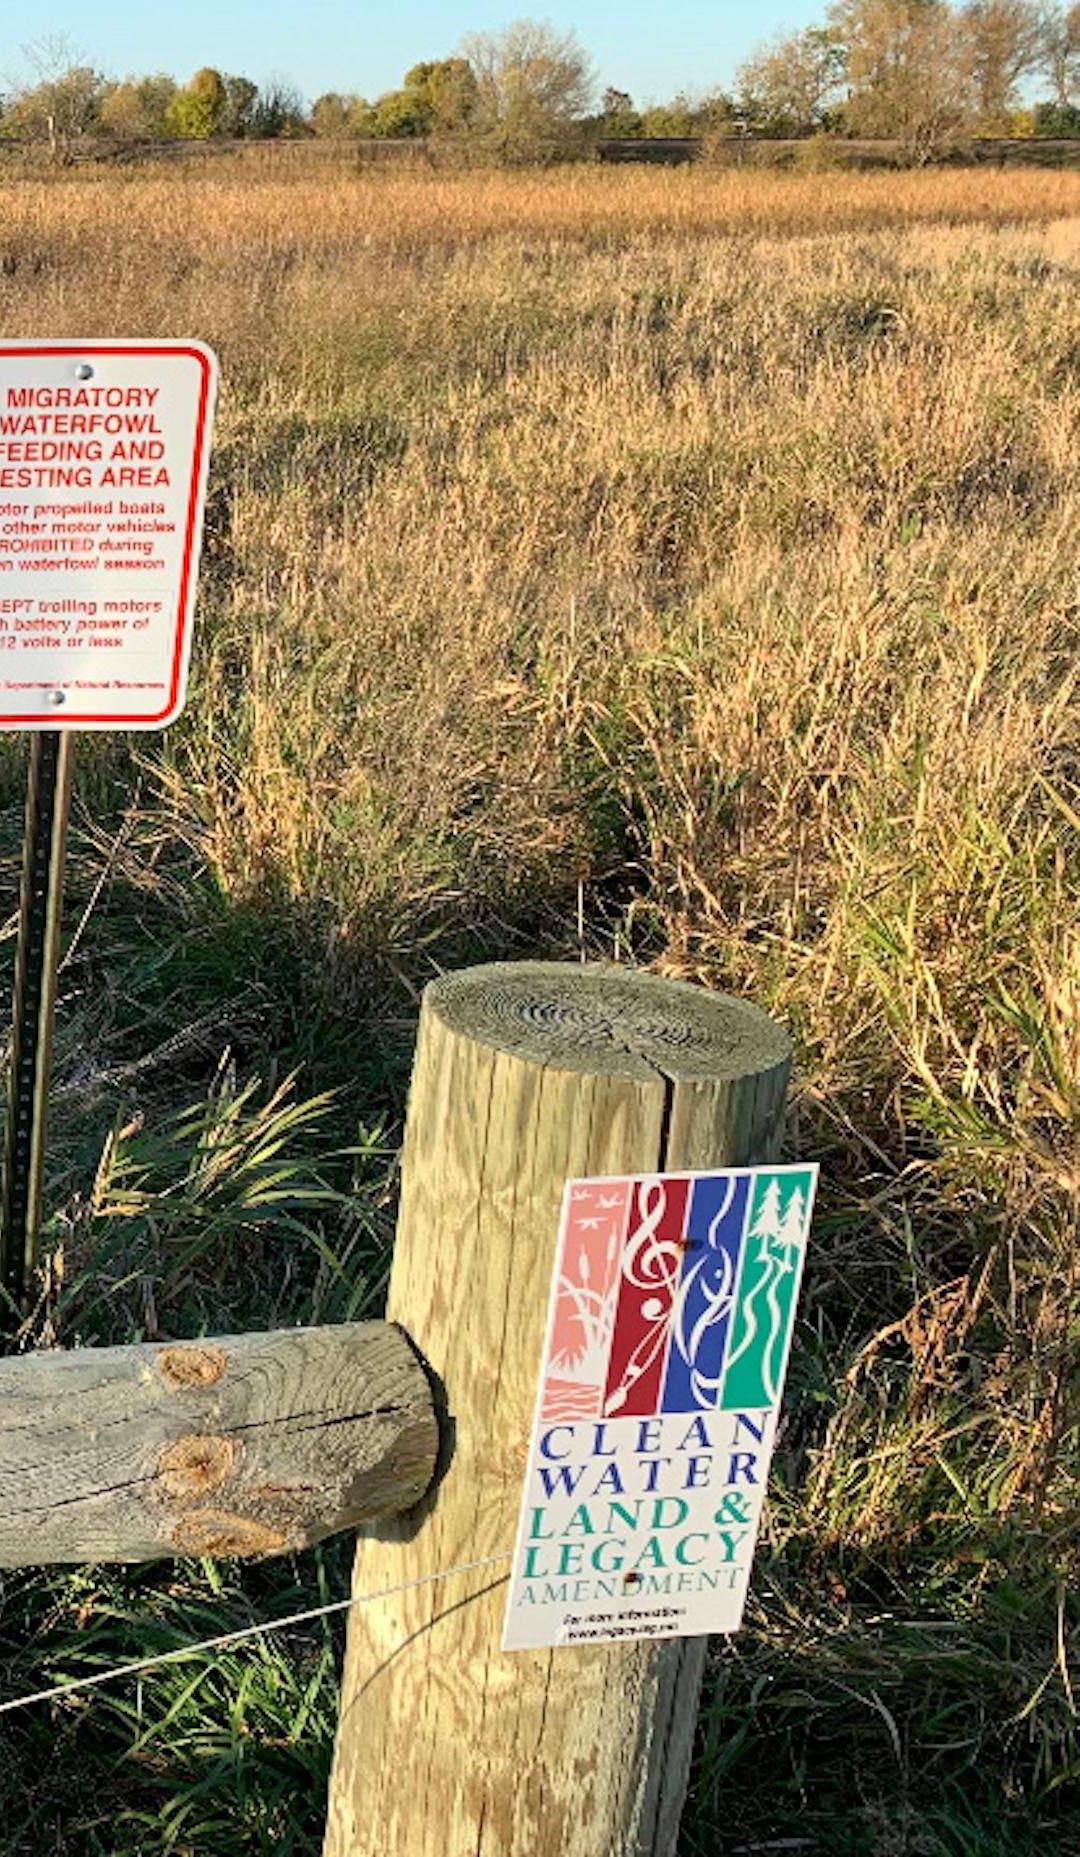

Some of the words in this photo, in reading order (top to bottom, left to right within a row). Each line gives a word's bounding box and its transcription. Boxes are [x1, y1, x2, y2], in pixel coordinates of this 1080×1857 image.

[7, 388, 159, 408] MIGRATORY
[0, 414, 162, 435] WATERFOWL
[110, 440, 165, 461] AND
[100, 467, 170, 487] AREA
[34, 501, 112, 520] propelled
[120, 501, 165, 515] boats
[2, 520, 46, 535] other
[52, 520, 101, 534] motor
[107, 518, 175, 533] vehicles
[99, 537, 154, 555] during
[20, 556, 99, 571] waterfowl
[104, 560, 165, 570] season
[39, 599, 98, 615] trolling
[104, 599, 162, 614] motors
[14, 617, 71, 634] battery
[75, 619, 127, 634] power
[132, 617, 150, 630] of
[0, 635, 16, 649] 12
[22, 635, 60, 649] volts
[67, 638, 83, 648] or
[89, 635, 123, 648] less
[539, 1410, 772, 1461] CLEAN
[537, 1451, 760, 1500] WATER
[529, 1495, 690, 1540] LAND
[713, 1490, 753, 1526] &
[522, 1530, 749, 1579] LEGACY
[517, 1566, 744, 1607] AMENDMENT
